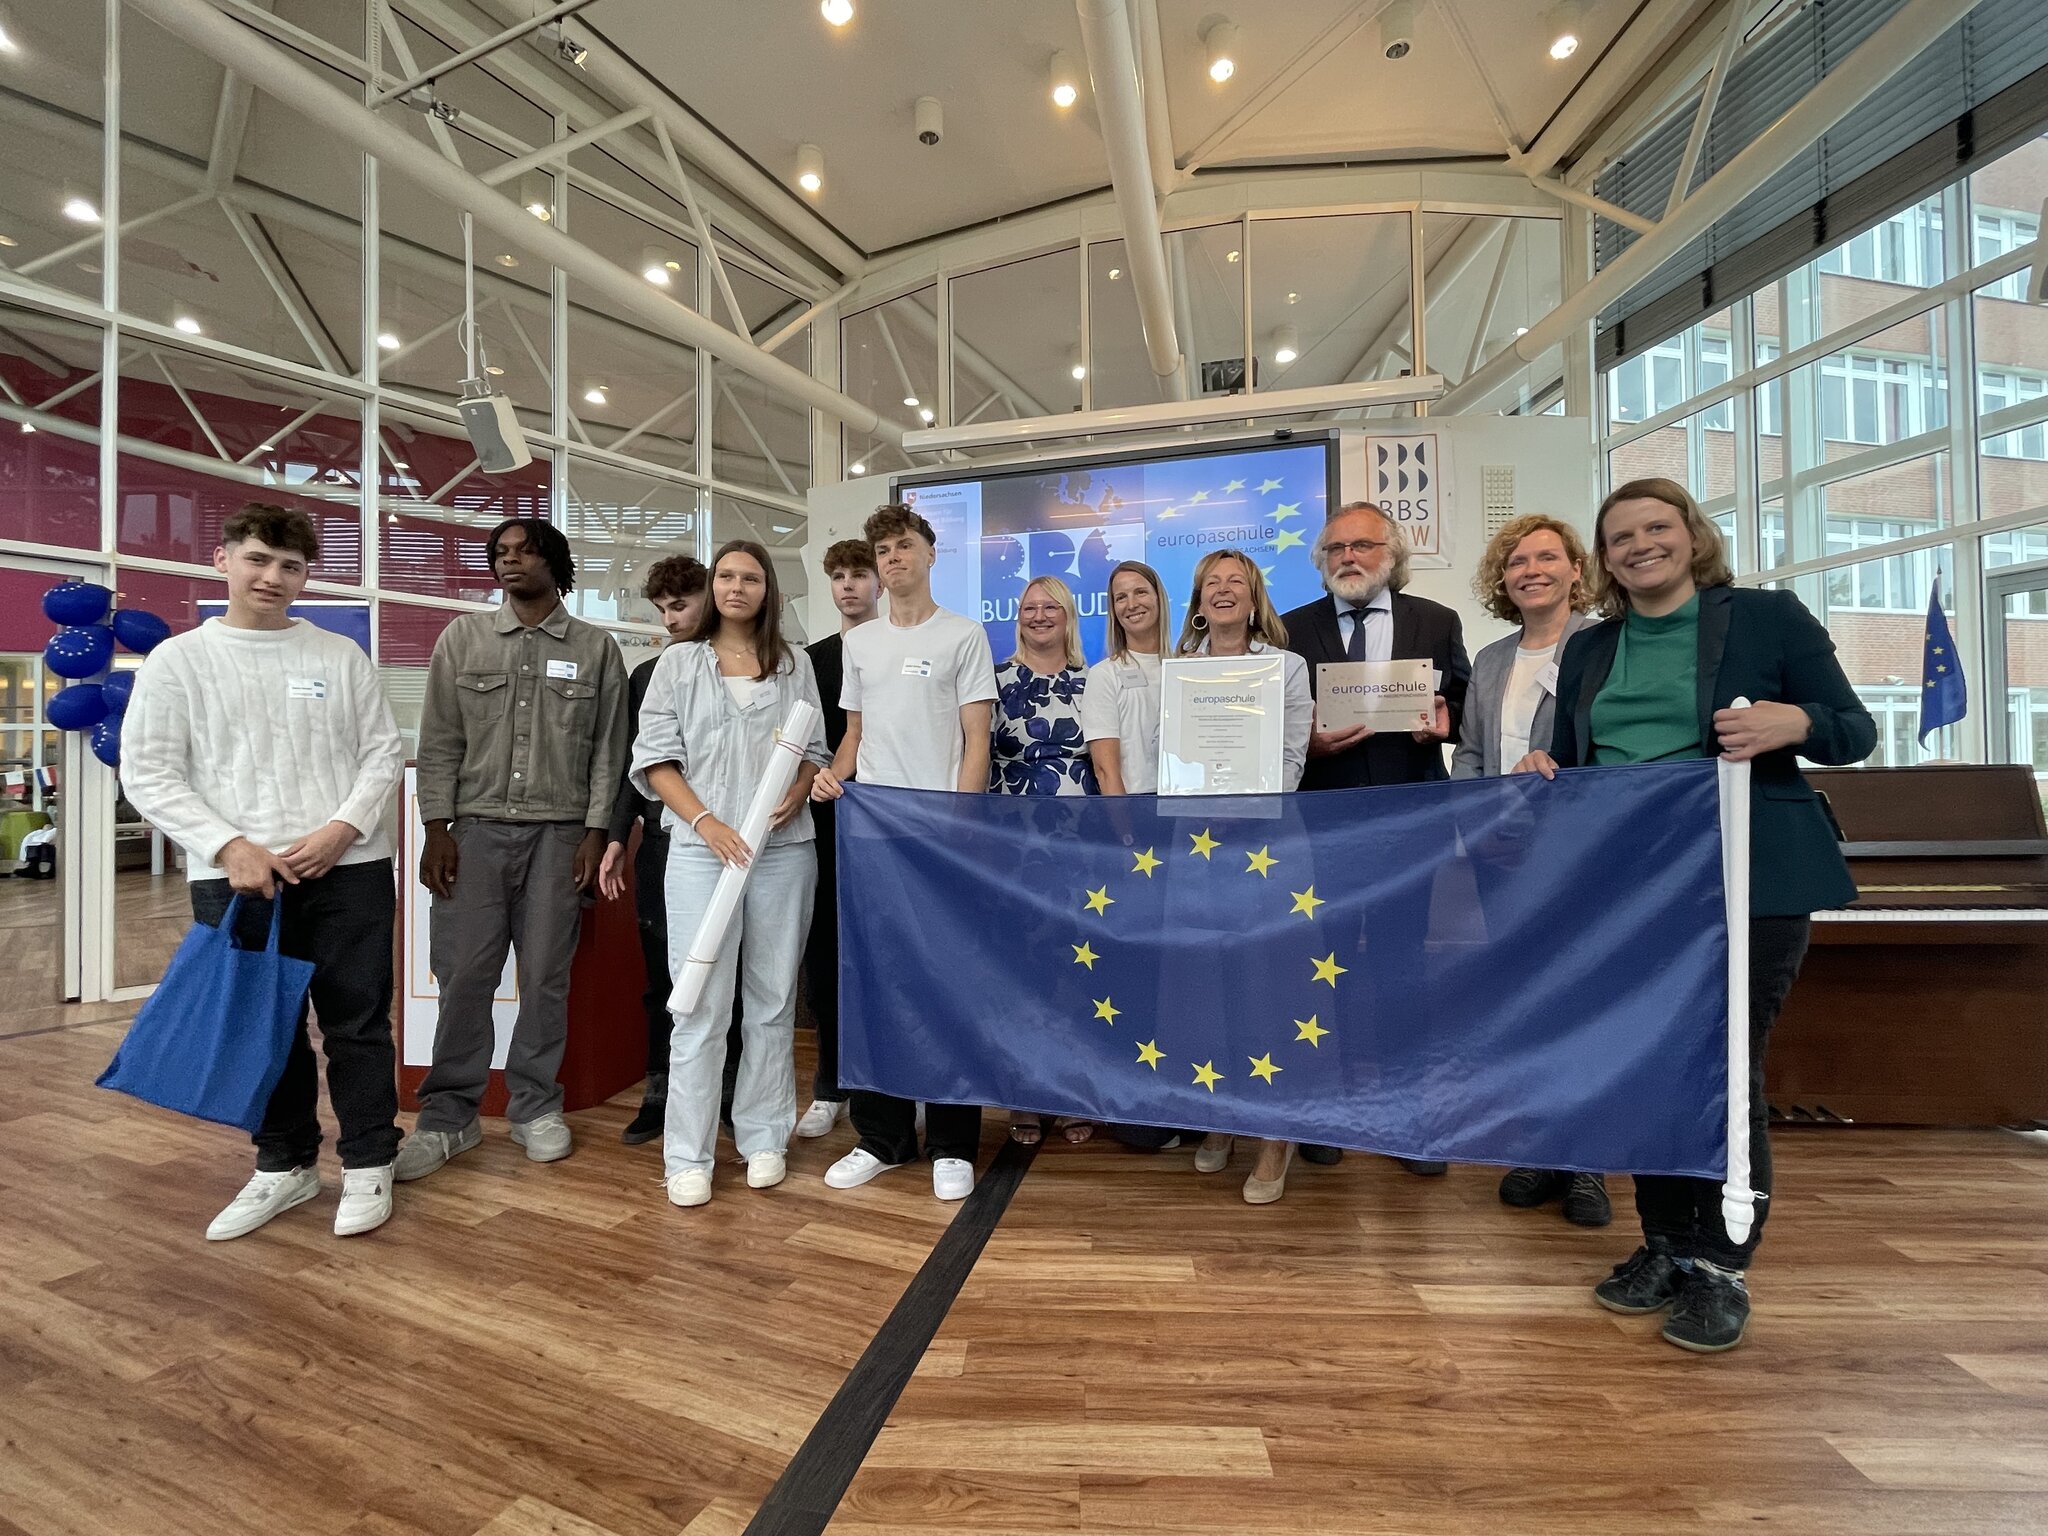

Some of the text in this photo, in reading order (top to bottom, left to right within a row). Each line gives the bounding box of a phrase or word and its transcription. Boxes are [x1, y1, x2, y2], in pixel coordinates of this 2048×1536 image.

[1379, 499, 1429, 521] BBS
[1157, 525, 1275, 548] europaschule
[1331, 681, 1427, 695] europaschule
[1193, 694, 1256, 704] europaschule
